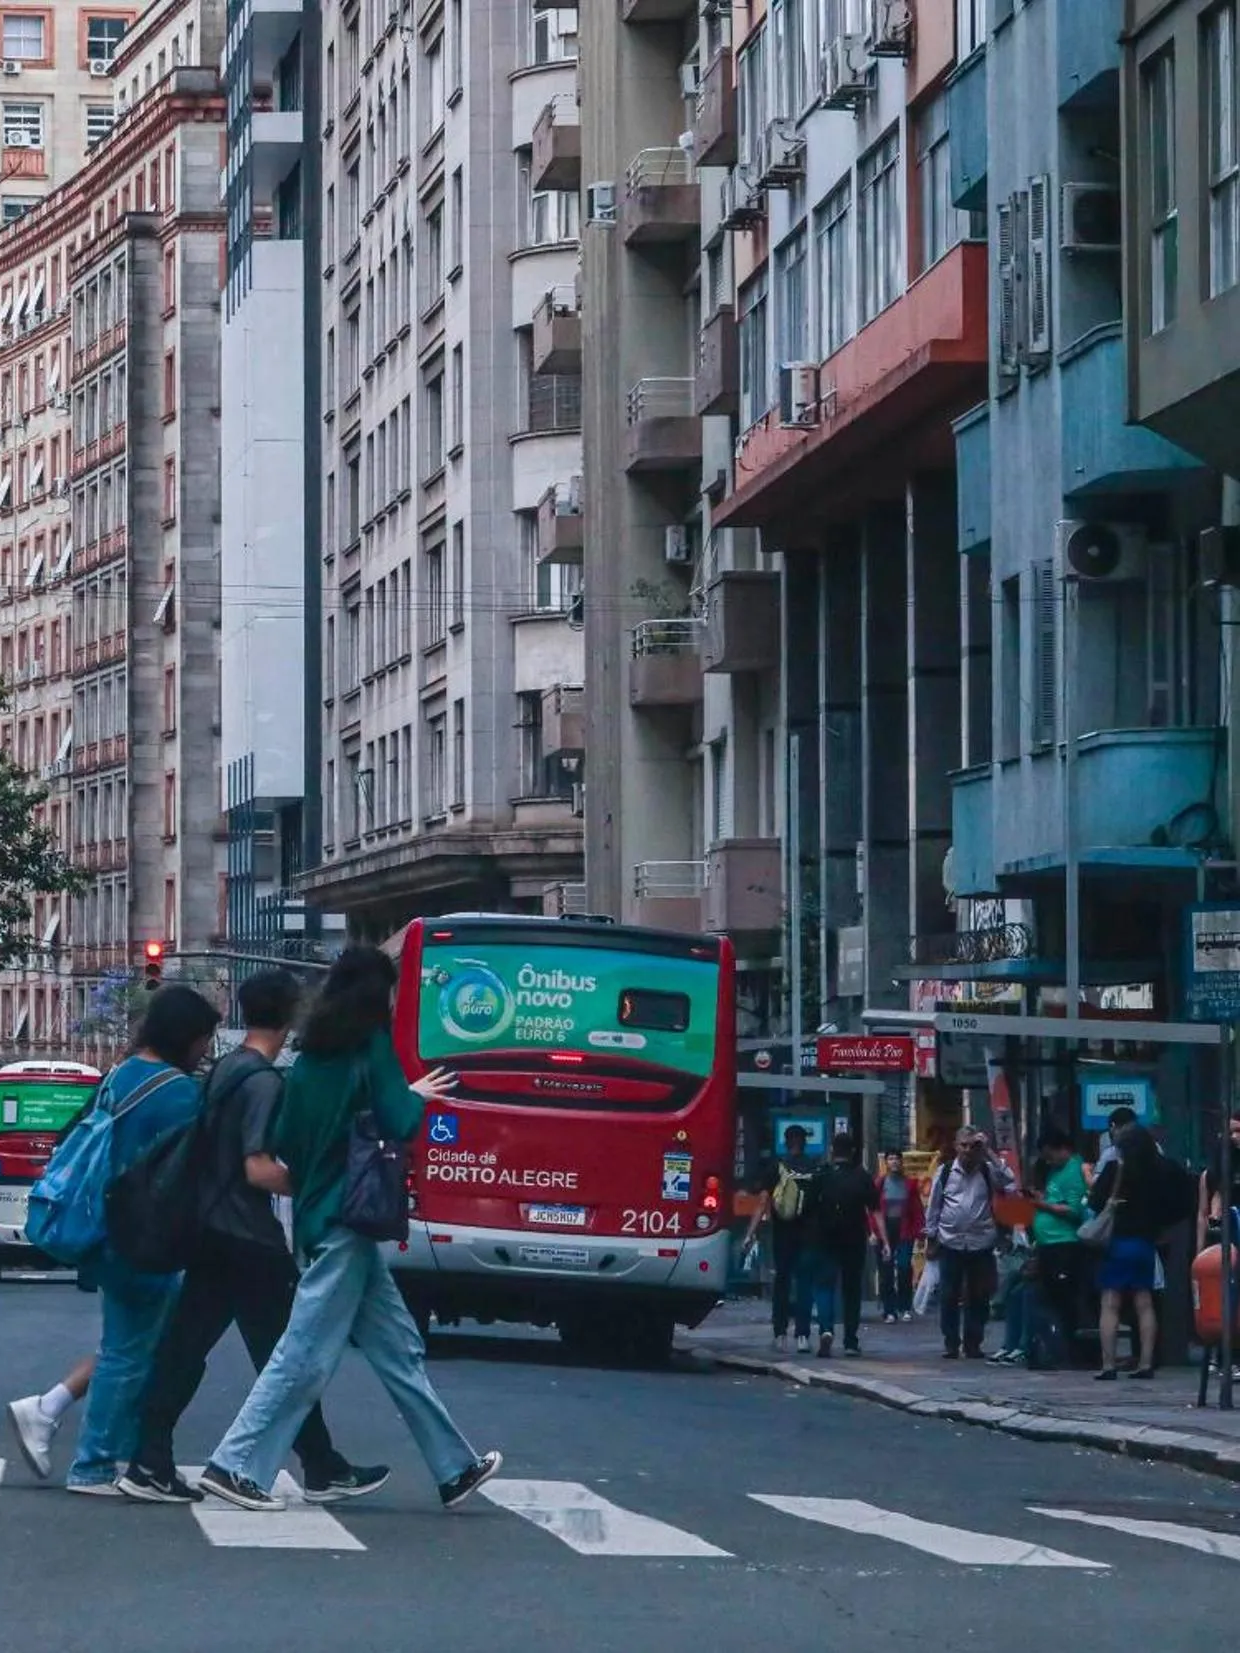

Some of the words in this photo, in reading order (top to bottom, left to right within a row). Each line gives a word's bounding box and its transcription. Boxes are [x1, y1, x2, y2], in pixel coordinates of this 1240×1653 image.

[517, 963, 596, 992] Ônibus
[516, 991, 573, 1009] novo
[461, 1003, 492, 1017] puro
[515, 1028, 554, 1041] EURO
[427, 1148, 476, 1164] Cidade
[479, 1152, 497, 1165] de
[426, 1165, 495, 1184] PORTO
[498, 1169, 578, 1189] ALEGRE
[621, 1209, 681, 1235] 2104
